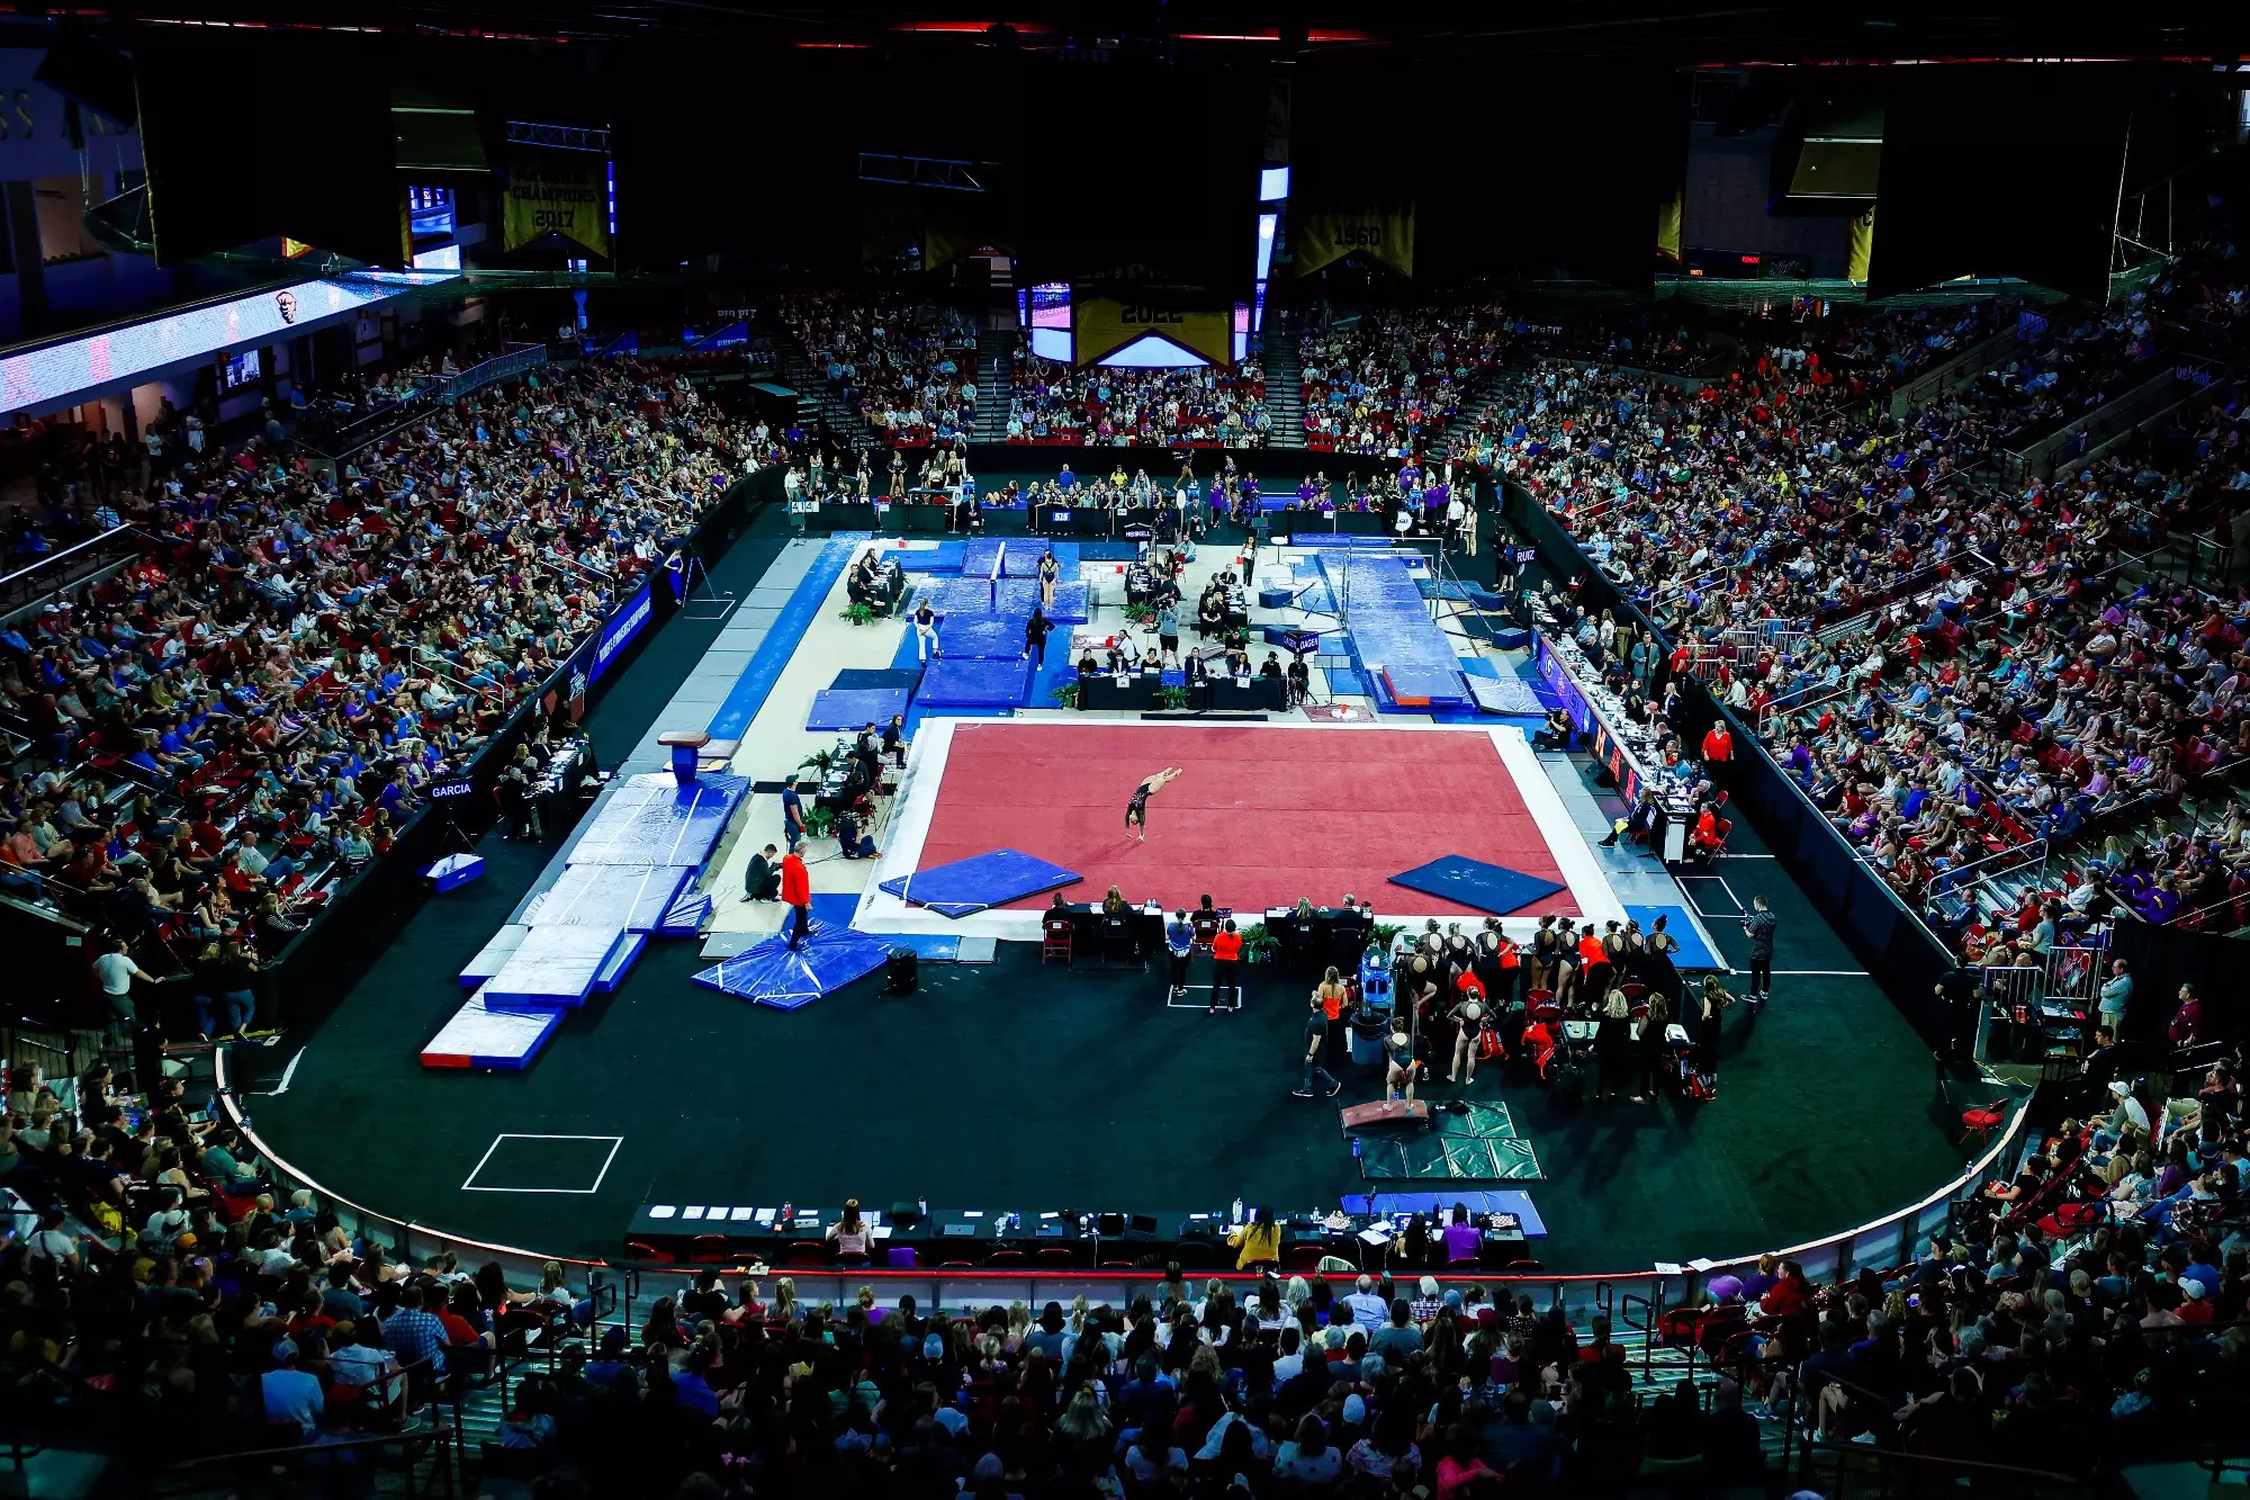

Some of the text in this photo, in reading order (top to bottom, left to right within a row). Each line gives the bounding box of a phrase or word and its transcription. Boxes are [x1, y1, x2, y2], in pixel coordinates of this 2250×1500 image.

[535, 210, 574, 228] 2017
[1334, 224, 1382, 246] 1960
[1517, 549, 1535, 563] RUIZ
[432, 783, 472, 798] GARCIA
